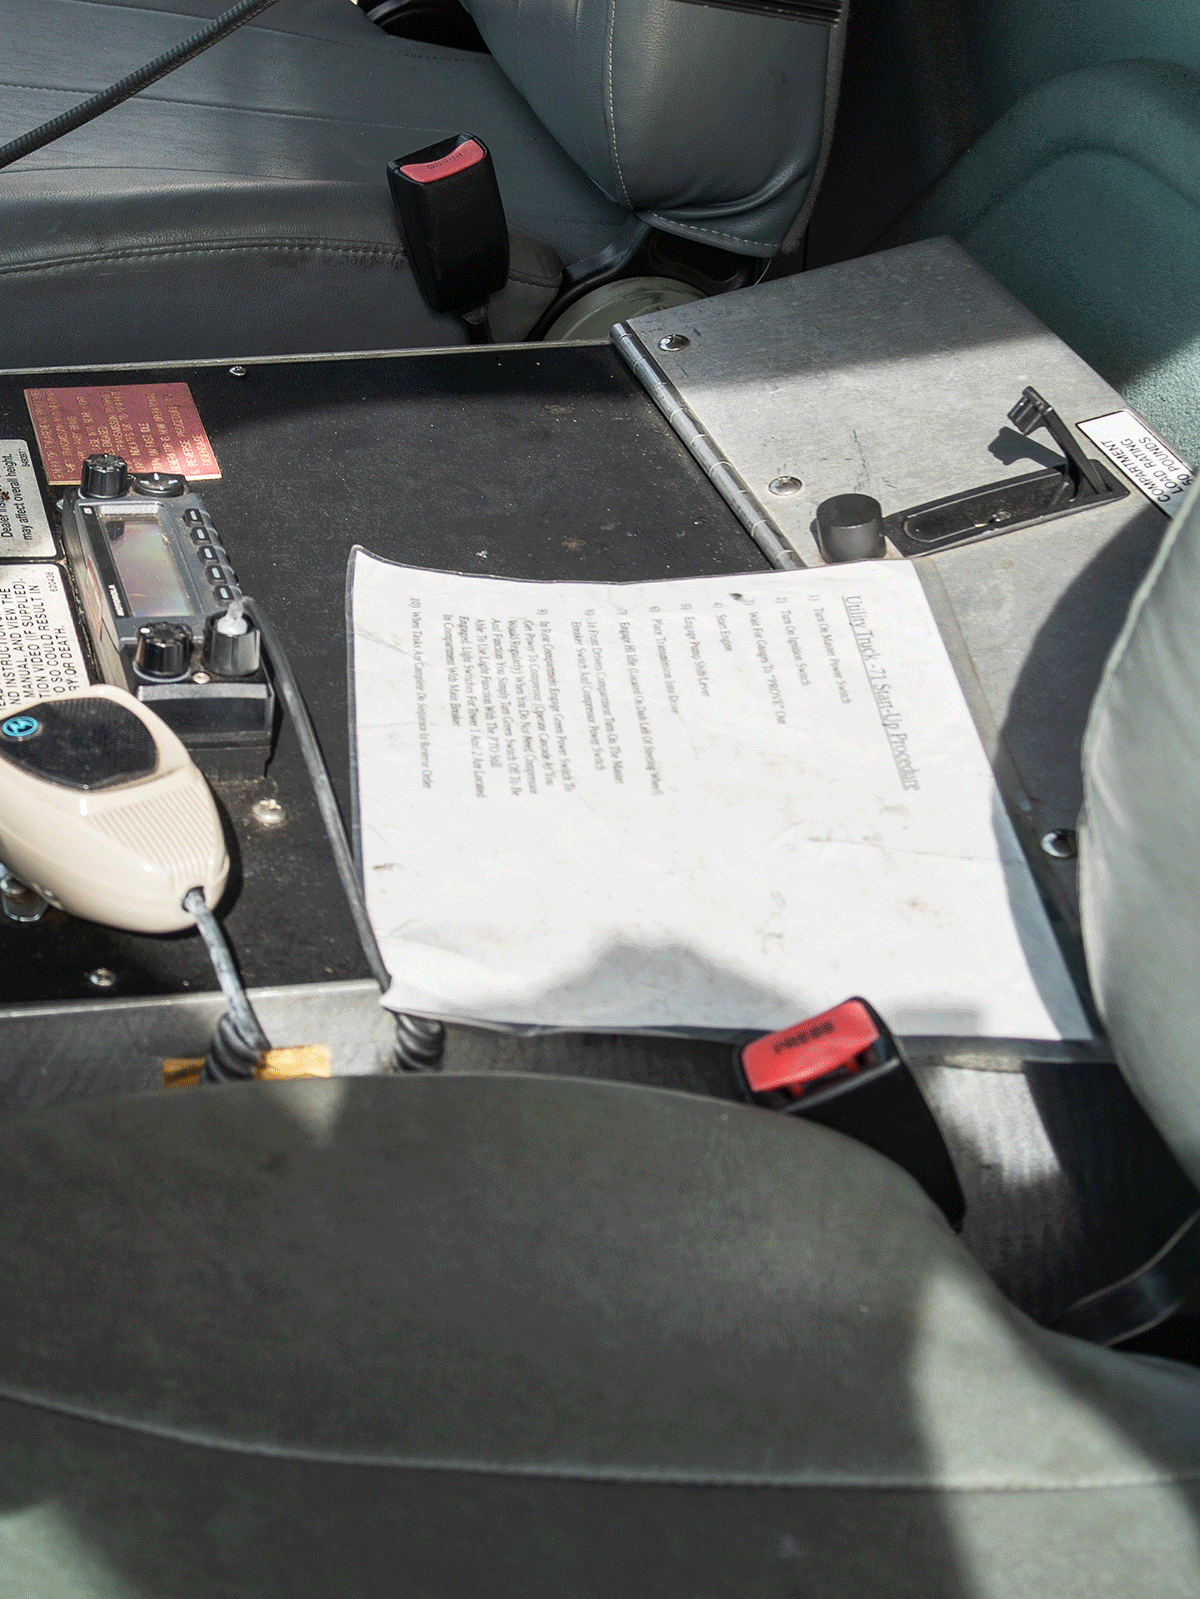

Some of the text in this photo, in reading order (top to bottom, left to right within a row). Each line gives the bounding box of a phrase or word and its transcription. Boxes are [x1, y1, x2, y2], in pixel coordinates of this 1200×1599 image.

[1139, 436, 1181, 472] POUNDS
[1101, 440, 1171, 502] COMPARTMENT
[1121, 438, 1184, 494] LOAD RATING
[2, 454, 33, 540] may affect overall height.
[29, 585, 40, 594] IN
[31, 597, 49, 630] RESULT
[717, 615, 730, 629] Start
[780, 610, 791, 624] Turn
[814, 607, 825, 622] Turn
[13, 578, 51, 698] TION VIDEO (IF SUPPLIED).
[682, 616, 696, 639] Engage
[785, 626, 794, 635] On
[819, 624, 828, 633] On
[0, 588, 35, 697] MANUAL, AND VIEW THE
[40, 634, 59, 665] COULD
[55, 625, 72, 658] DEATH.
[688, 642, 701, 659] Pump
[719, 631, 733, 651] Engine
[786, 637, 801, 661] Ignition
[822, 635, 835, 656] Master
[49, 669, 63, 682] SO
[62, 662, 77, 674] OR
[795, 663, 810, 686] Switch
[829, 659, 841, 678] Power
[7, 692, 21, 704] ND
[698, 678, 710, 697] Lever
[835, 680, 852, 704] Switch
[845, 596, 921, 791] Utility Truck -71 Start-Up Procedure
